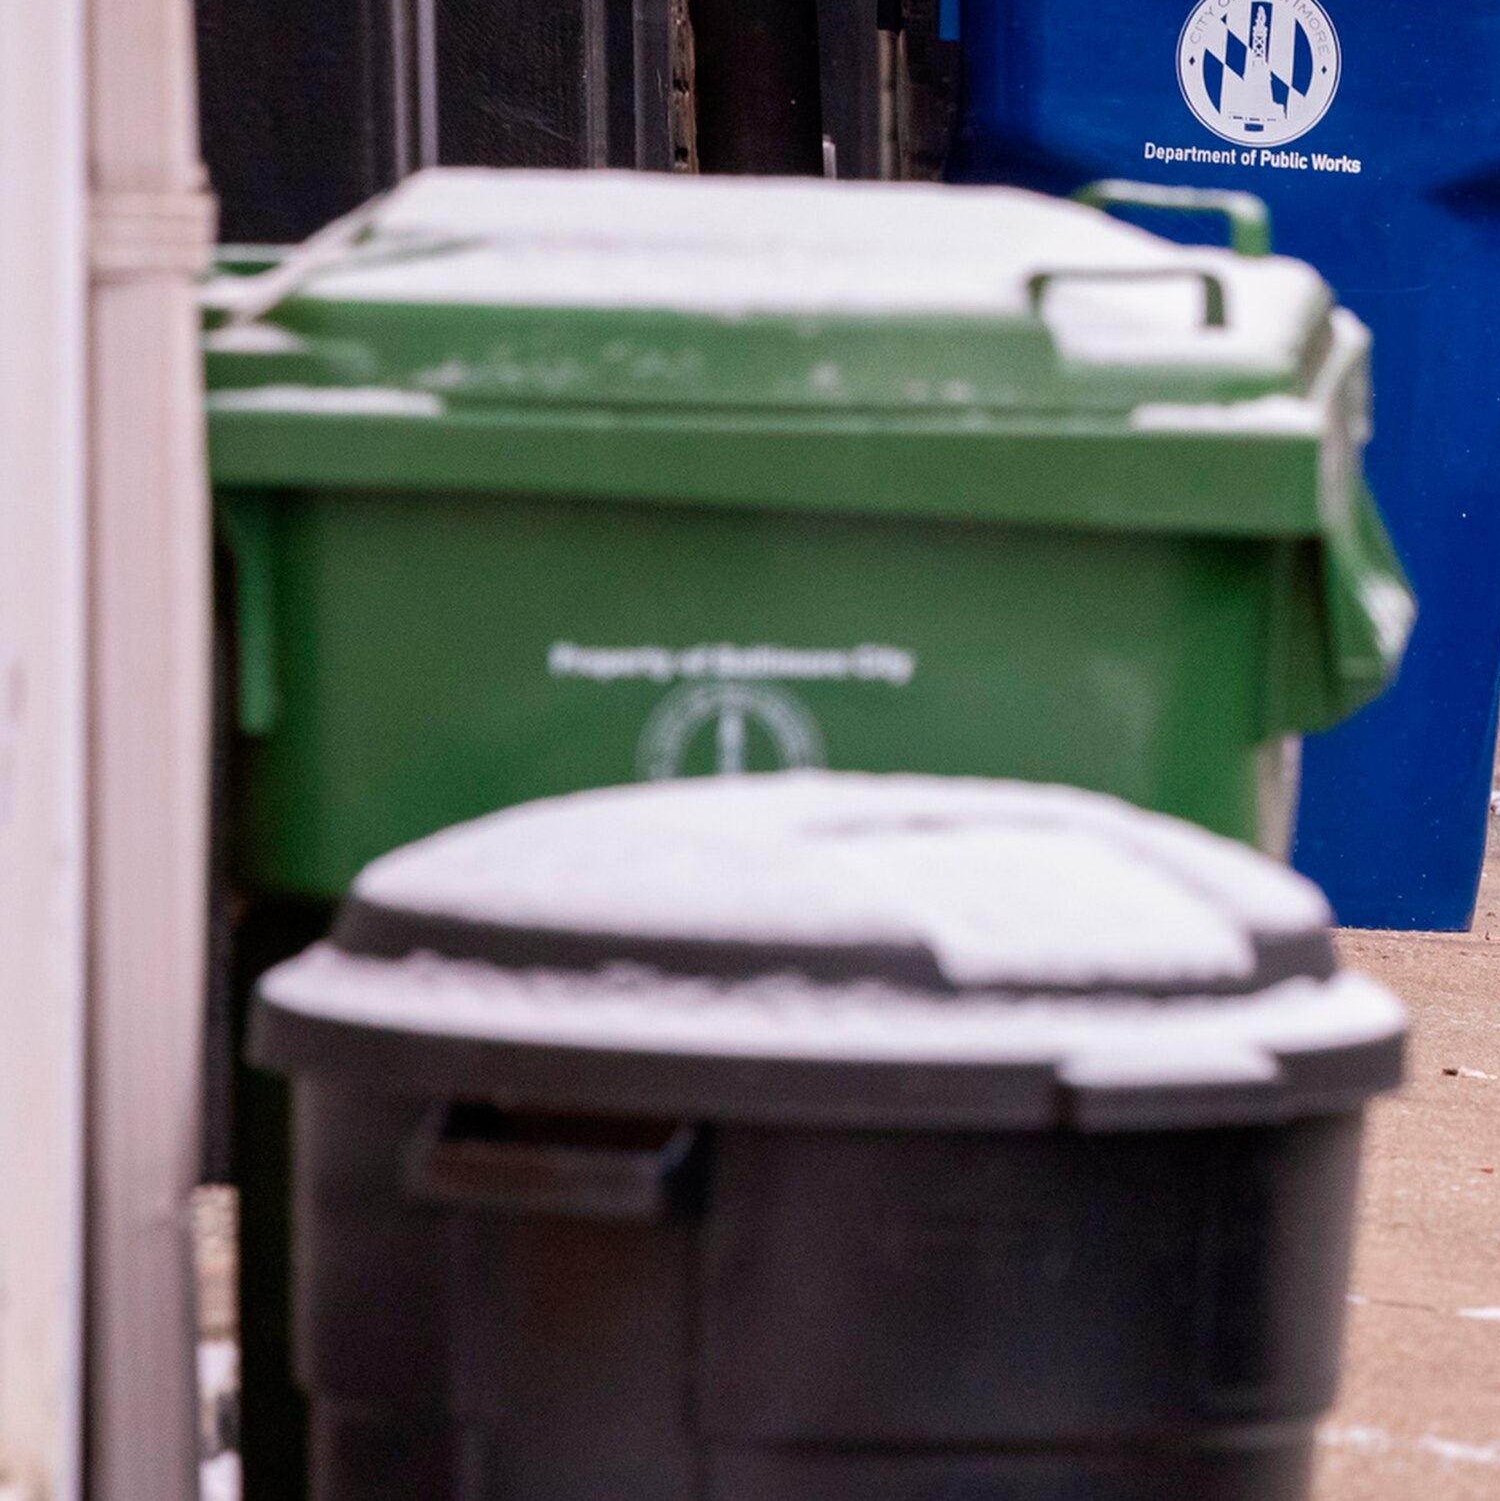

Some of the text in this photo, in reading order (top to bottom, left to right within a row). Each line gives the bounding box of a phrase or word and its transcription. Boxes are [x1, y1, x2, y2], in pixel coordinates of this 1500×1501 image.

[1189, 5, 1216, 45] CITY
[1143, 141, 1362, 174] Department of Public Works
